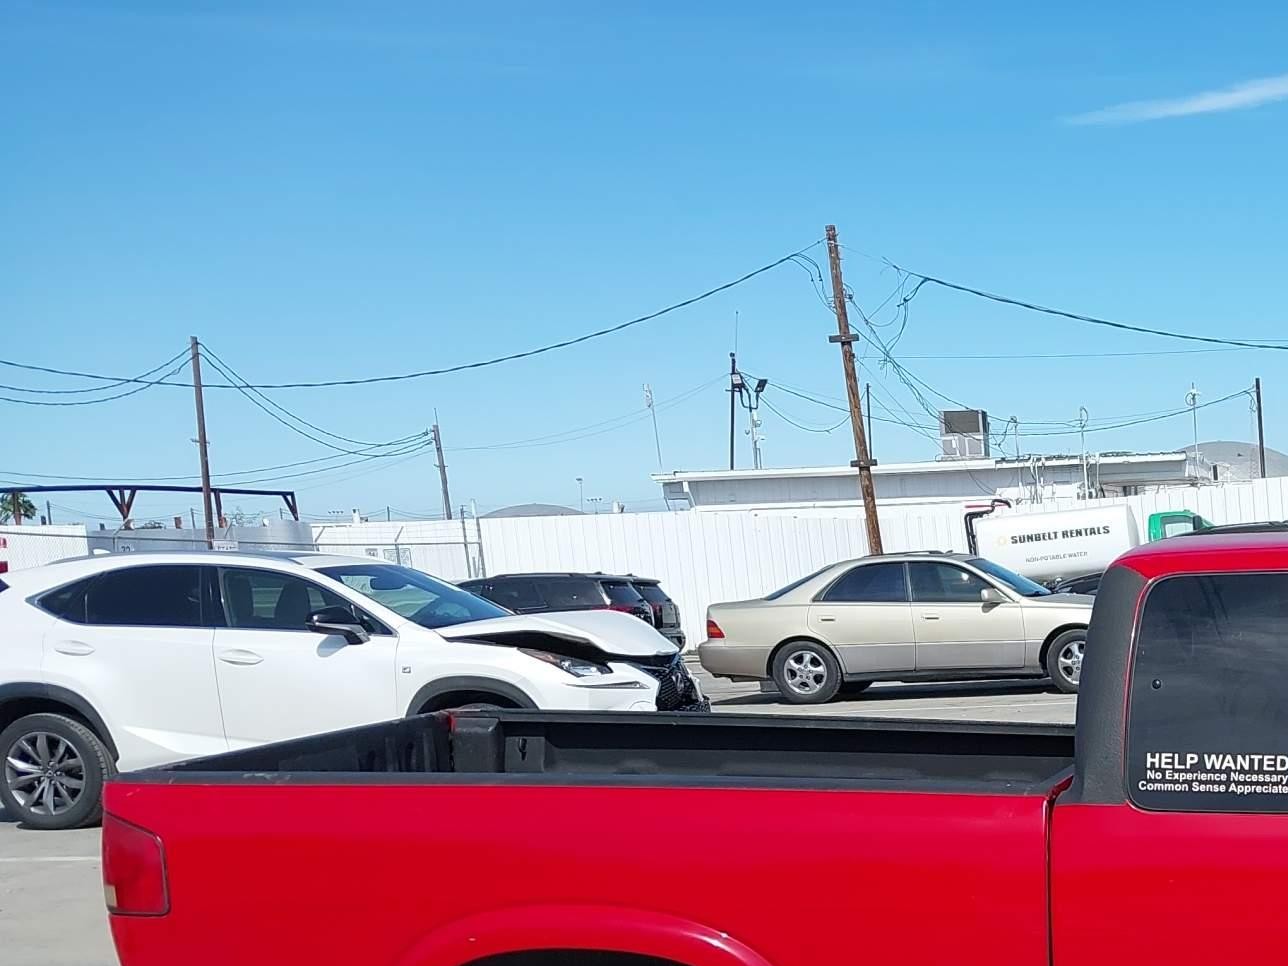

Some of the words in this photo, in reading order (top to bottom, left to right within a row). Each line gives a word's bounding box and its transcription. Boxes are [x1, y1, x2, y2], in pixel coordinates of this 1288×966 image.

[1010, 531, 1059, 544] SUNBELT
[1061, 525, 1110, 539] RENTALS
[1067, 551, 1088, 559] WATER
[1146, 752, 1199, 770] HELP
[1146, 770, 1162, 780] No
[1165, 770, 1227, 782] Experience
[1230, 771, 1288, 785] Necessary
[1138, 780, 1189, 792] Common
[1191, 782, 1226, 793] Sense
